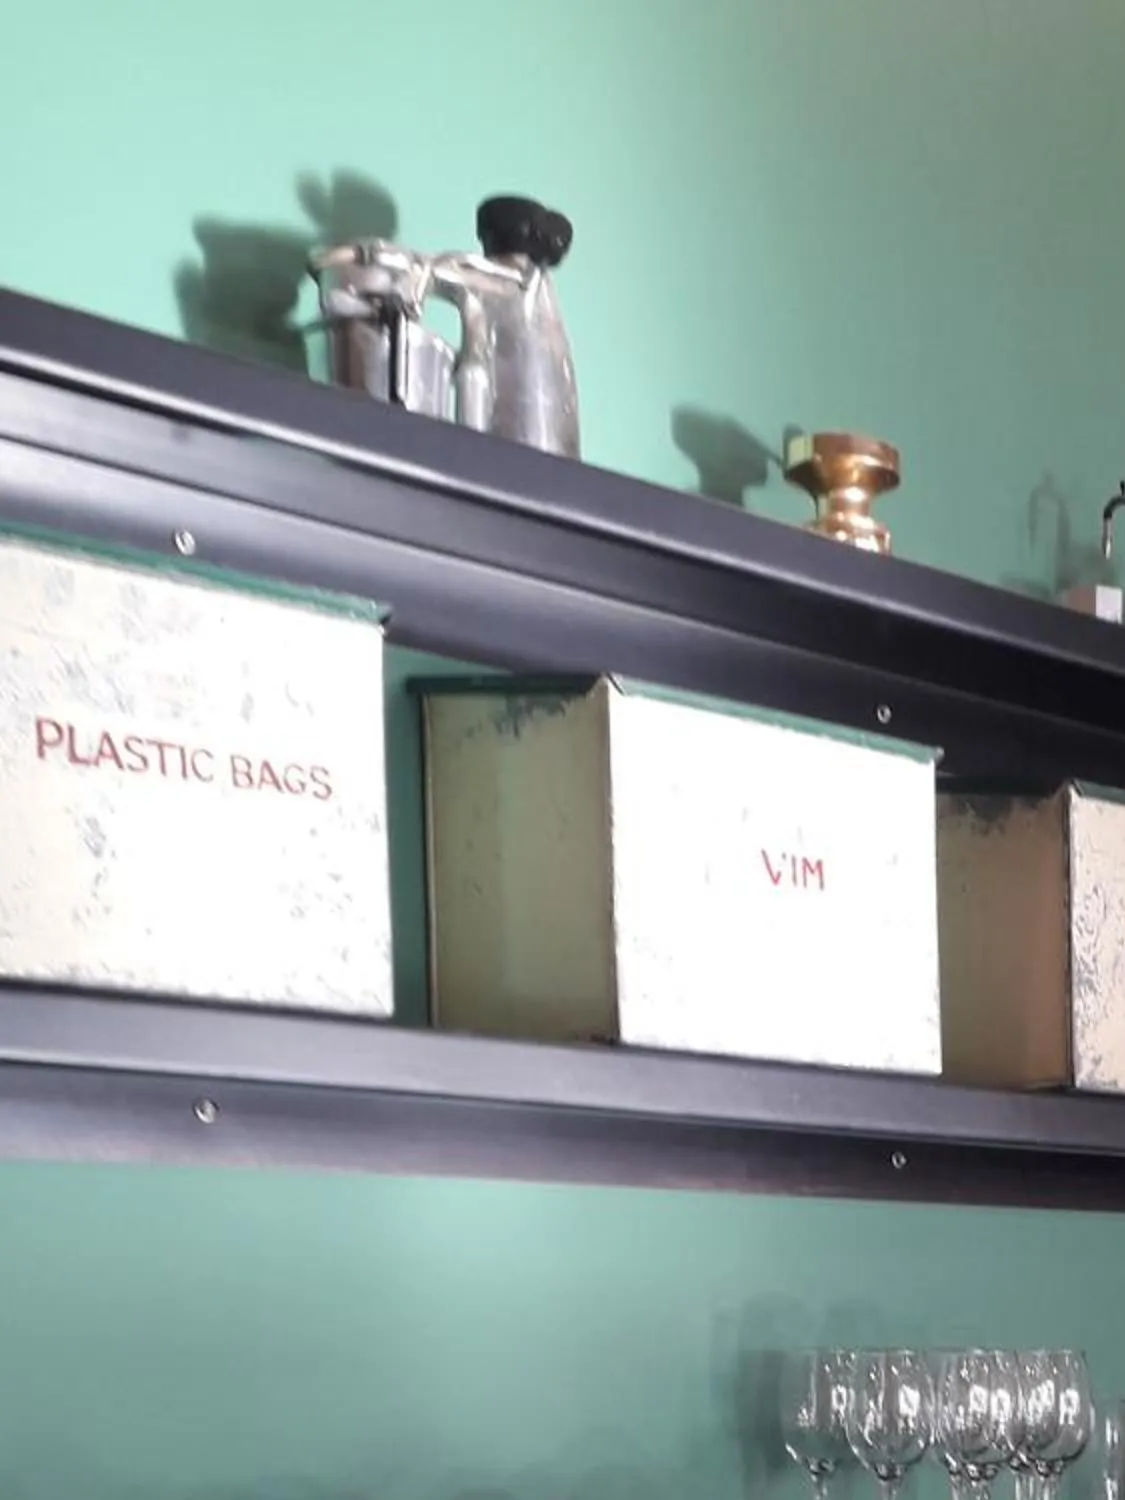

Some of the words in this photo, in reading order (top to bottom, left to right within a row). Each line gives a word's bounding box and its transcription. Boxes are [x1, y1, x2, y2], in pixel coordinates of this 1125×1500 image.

[34, 715, 215, 784] PLASTIC
[229, 753, 333, 802] BAGS
[760, 847, 825, 892] VIM
